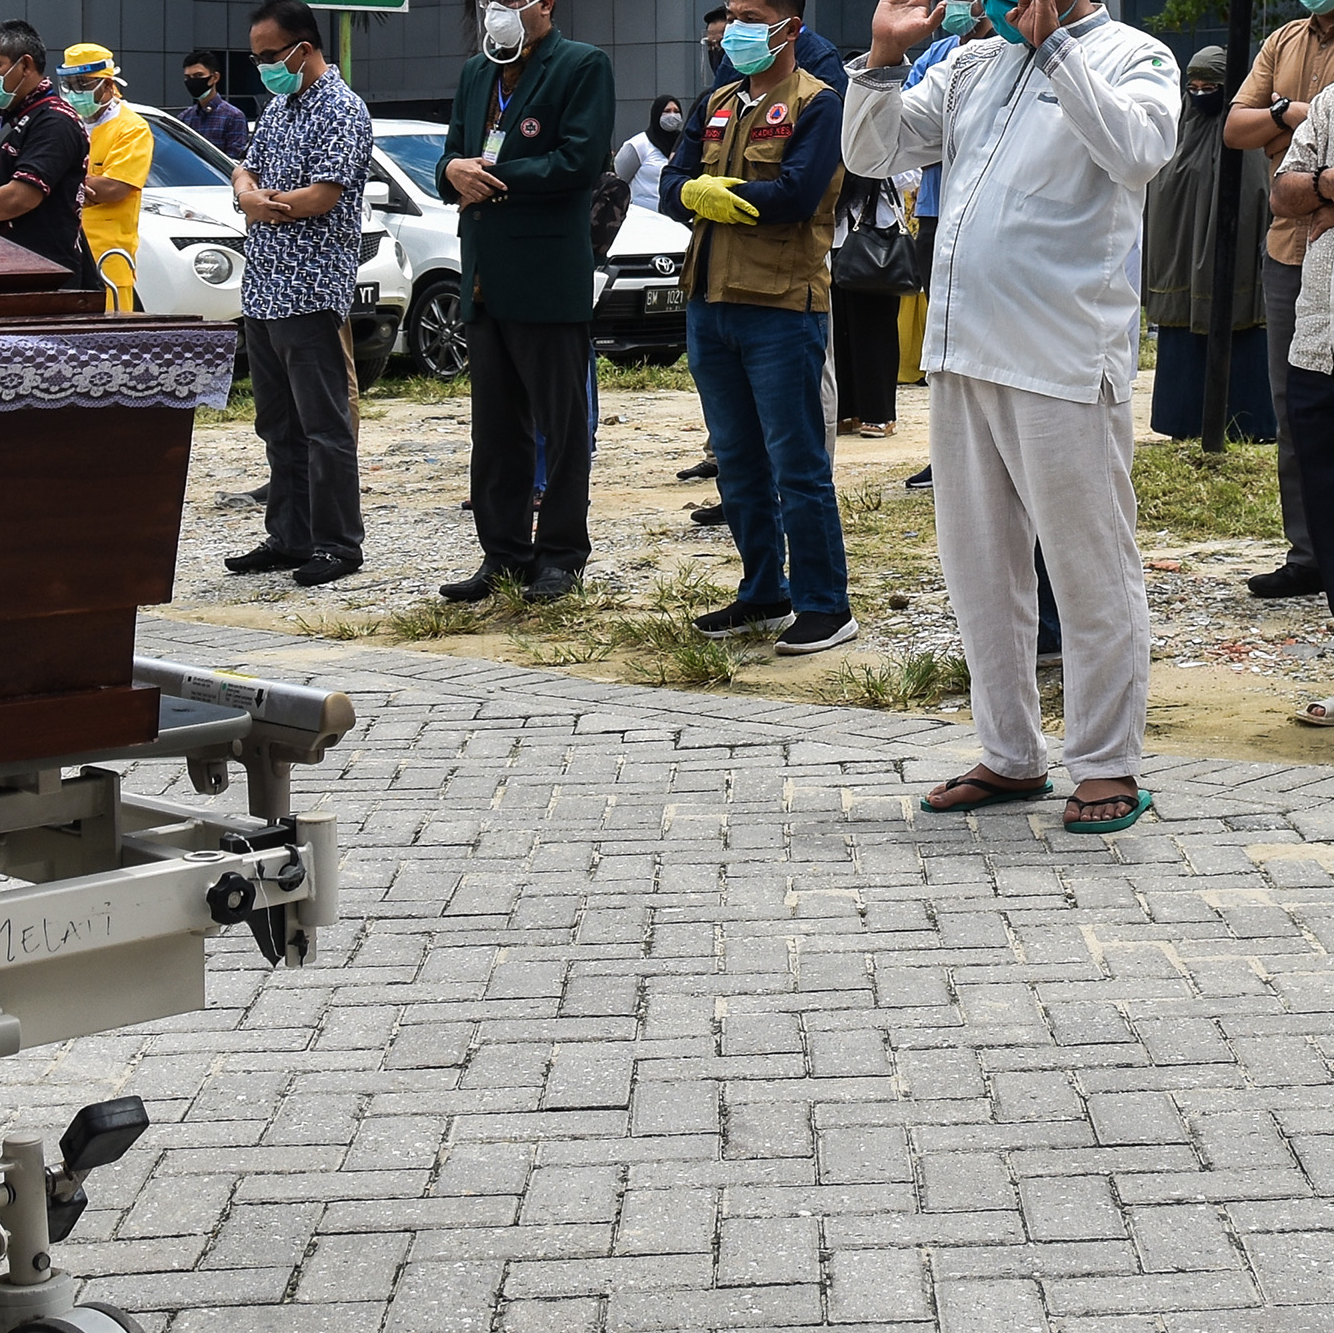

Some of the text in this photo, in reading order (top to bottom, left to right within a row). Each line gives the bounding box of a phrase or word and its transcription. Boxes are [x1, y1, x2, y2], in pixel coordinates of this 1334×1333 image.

[359, 286, 375, 304] YT
[646, 289, 684, 306] BM 1021
